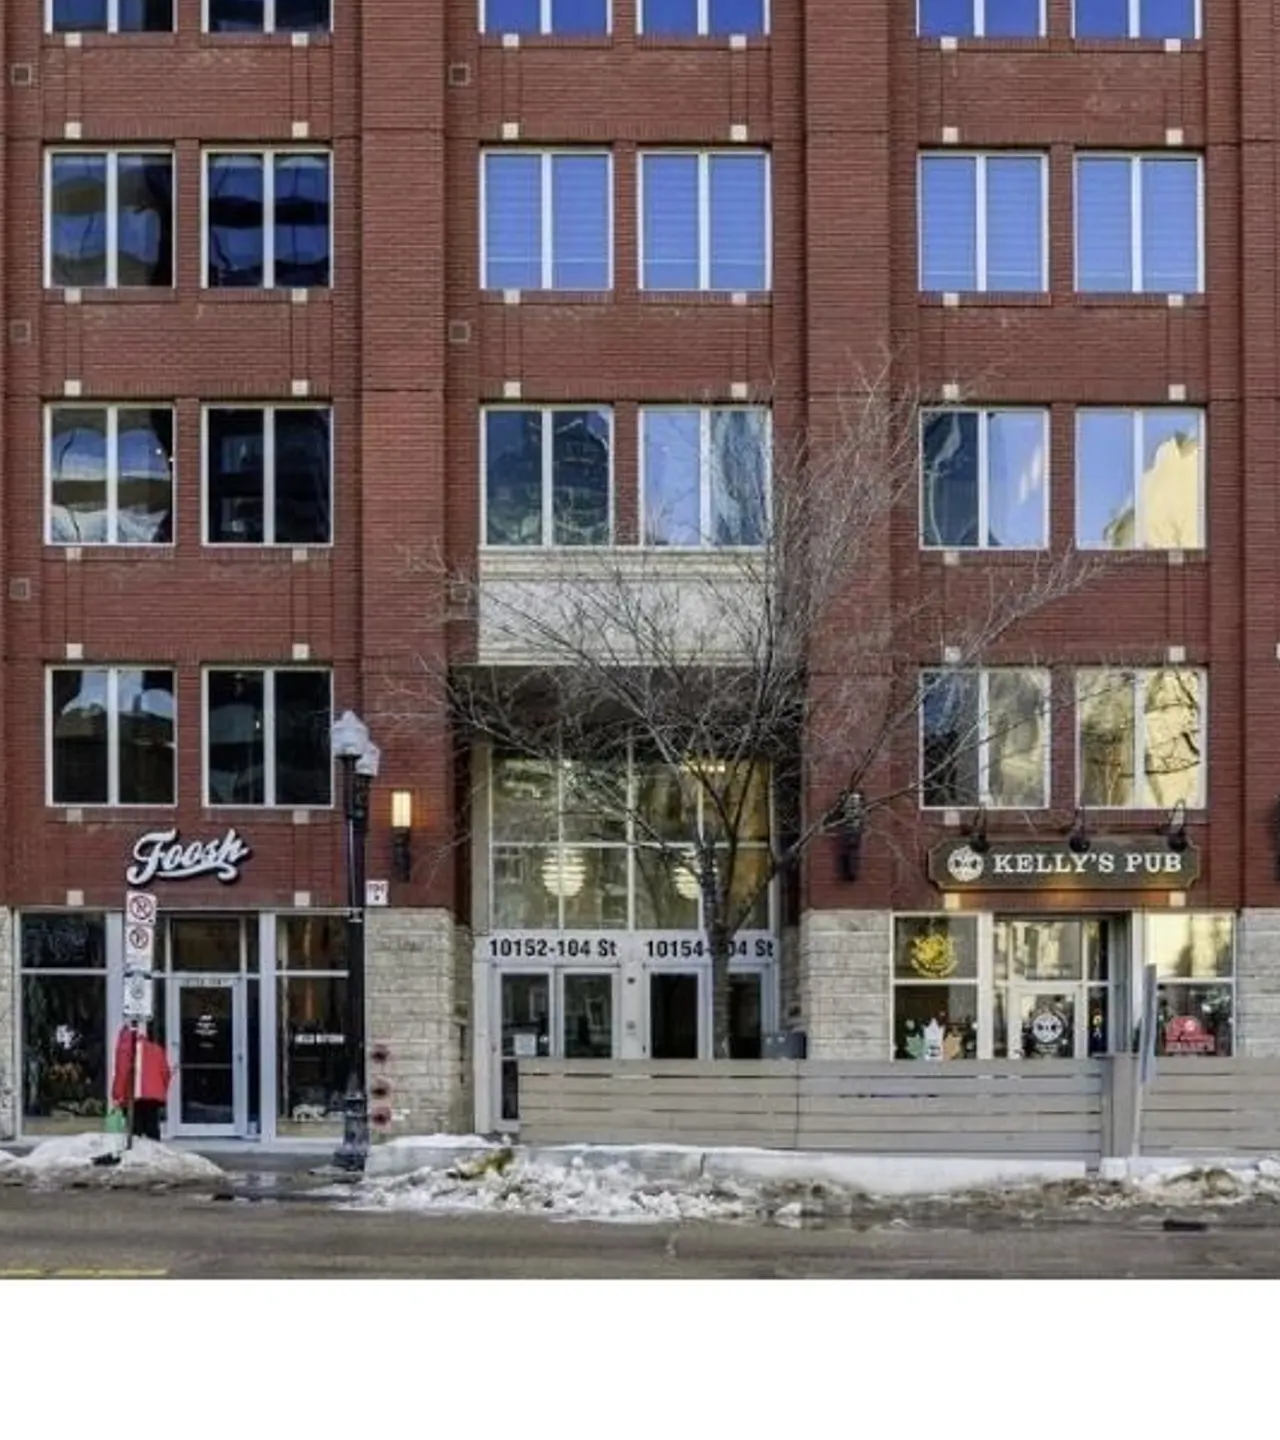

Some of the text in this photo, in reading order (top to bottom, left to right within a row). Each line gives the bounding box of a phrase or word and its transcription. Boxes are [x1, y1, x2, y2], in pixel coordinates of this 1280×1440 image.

[126, 828, 250, 885] Foosh
[992, 853, 1182, 873] KELLY'S PUB
[489, 938, 617, 957] 10152-104 St
[647, 938, 774, 958] 10154-04 St
